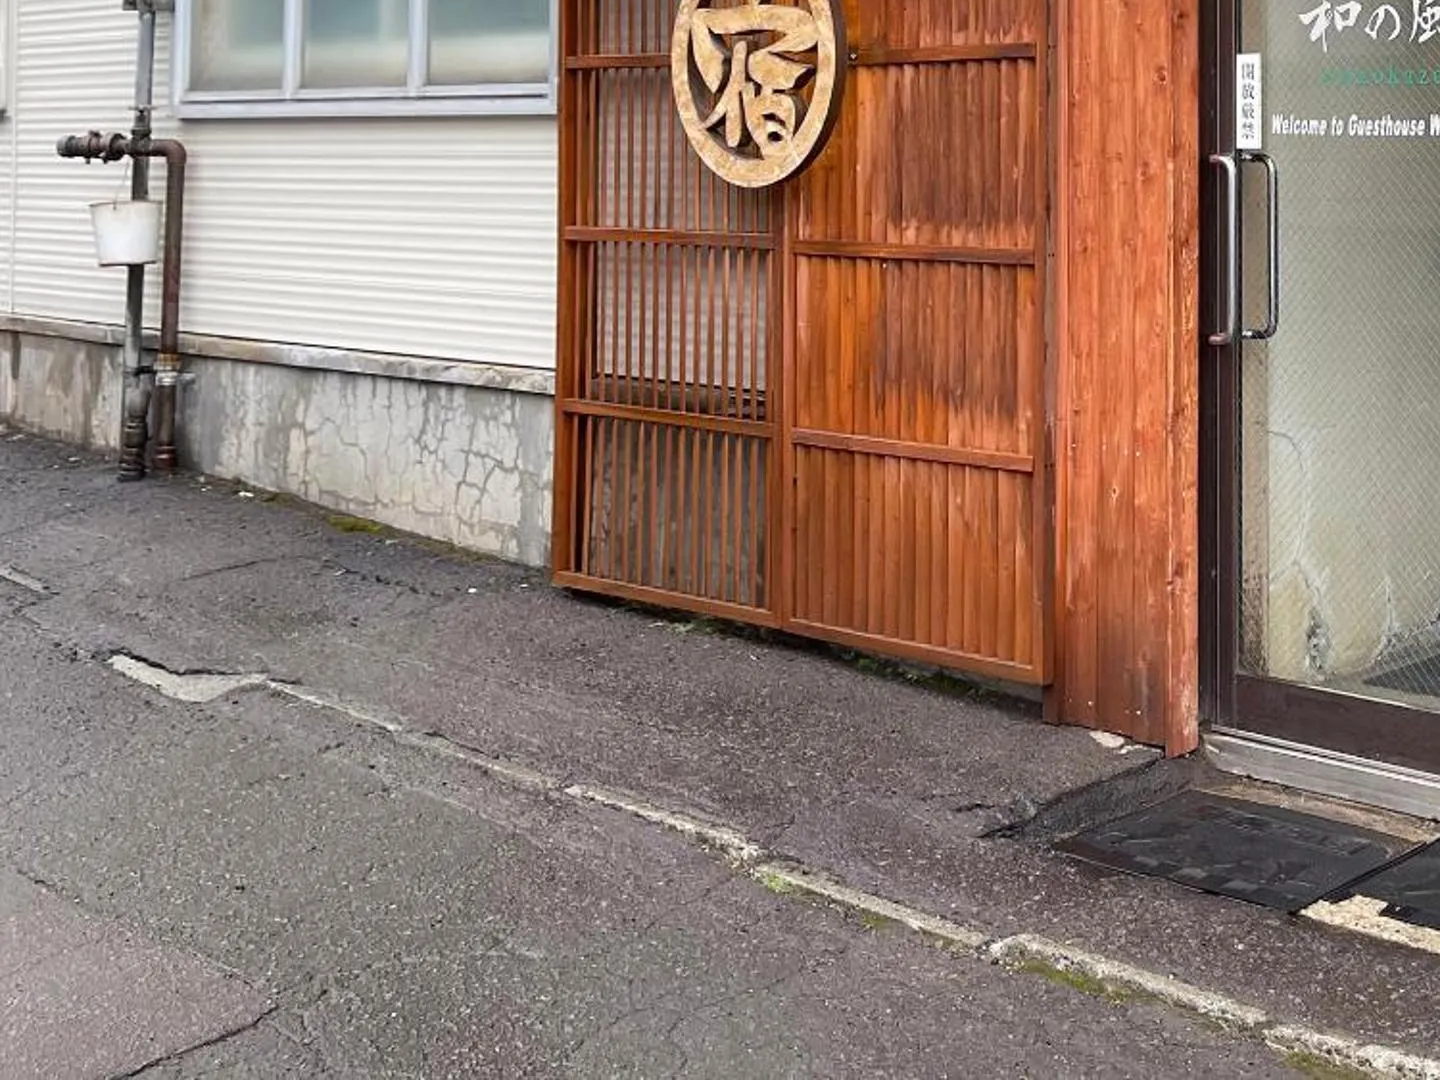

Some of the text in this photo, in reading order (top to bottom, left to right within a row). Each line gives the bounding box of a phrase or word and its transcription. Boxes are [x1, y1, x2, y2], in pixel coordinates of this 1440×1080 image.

[1271, 114, 1327, 136] Welcome
[1330, 116, 1344, 137] to
[1349, 113, 1426, 137] Guesthouse
